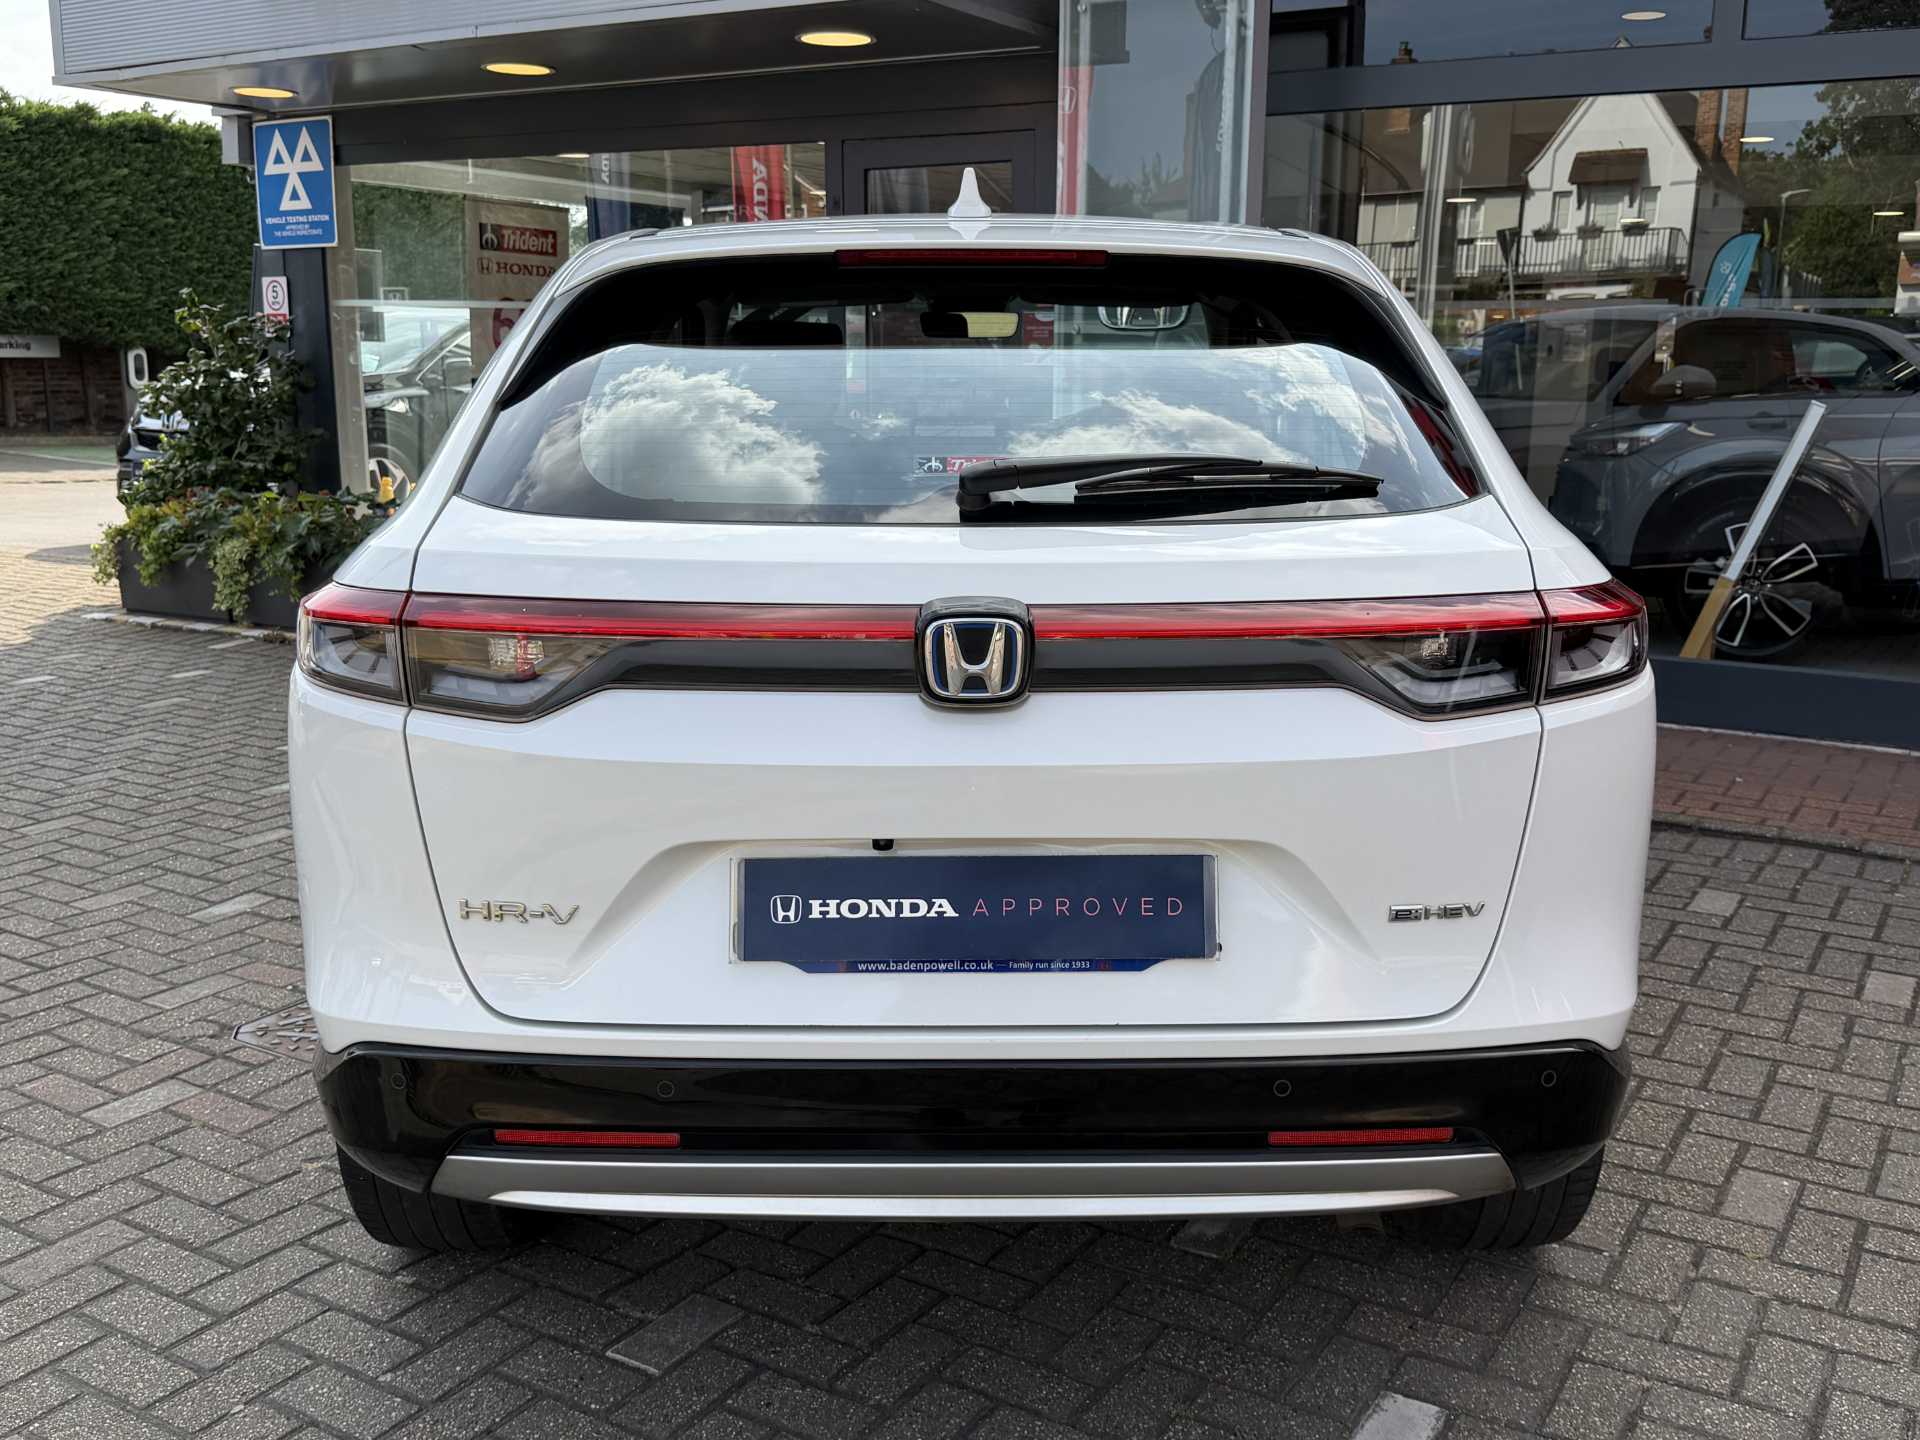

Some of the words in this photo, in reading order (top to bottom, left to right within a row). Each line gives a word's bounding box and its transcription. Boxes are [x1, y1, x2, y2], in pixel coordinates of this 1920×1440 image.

[502, 230, 553, 253] Trident
[272, 285, 278, 300] 5
[457, 898, 579, 925] HR-V
[808, 898, 960, 919] HONDA
[972, 897, 1184, 917] APPROVED
[857, 959, 994, 972] www.badenpowell.co.uk
[1009, 960, 1034, 969] Family
[1035, 961, 1049, 969] run
[1050, 960, 1070, 969] since
[1071, 960, 1090, 968] 1933
